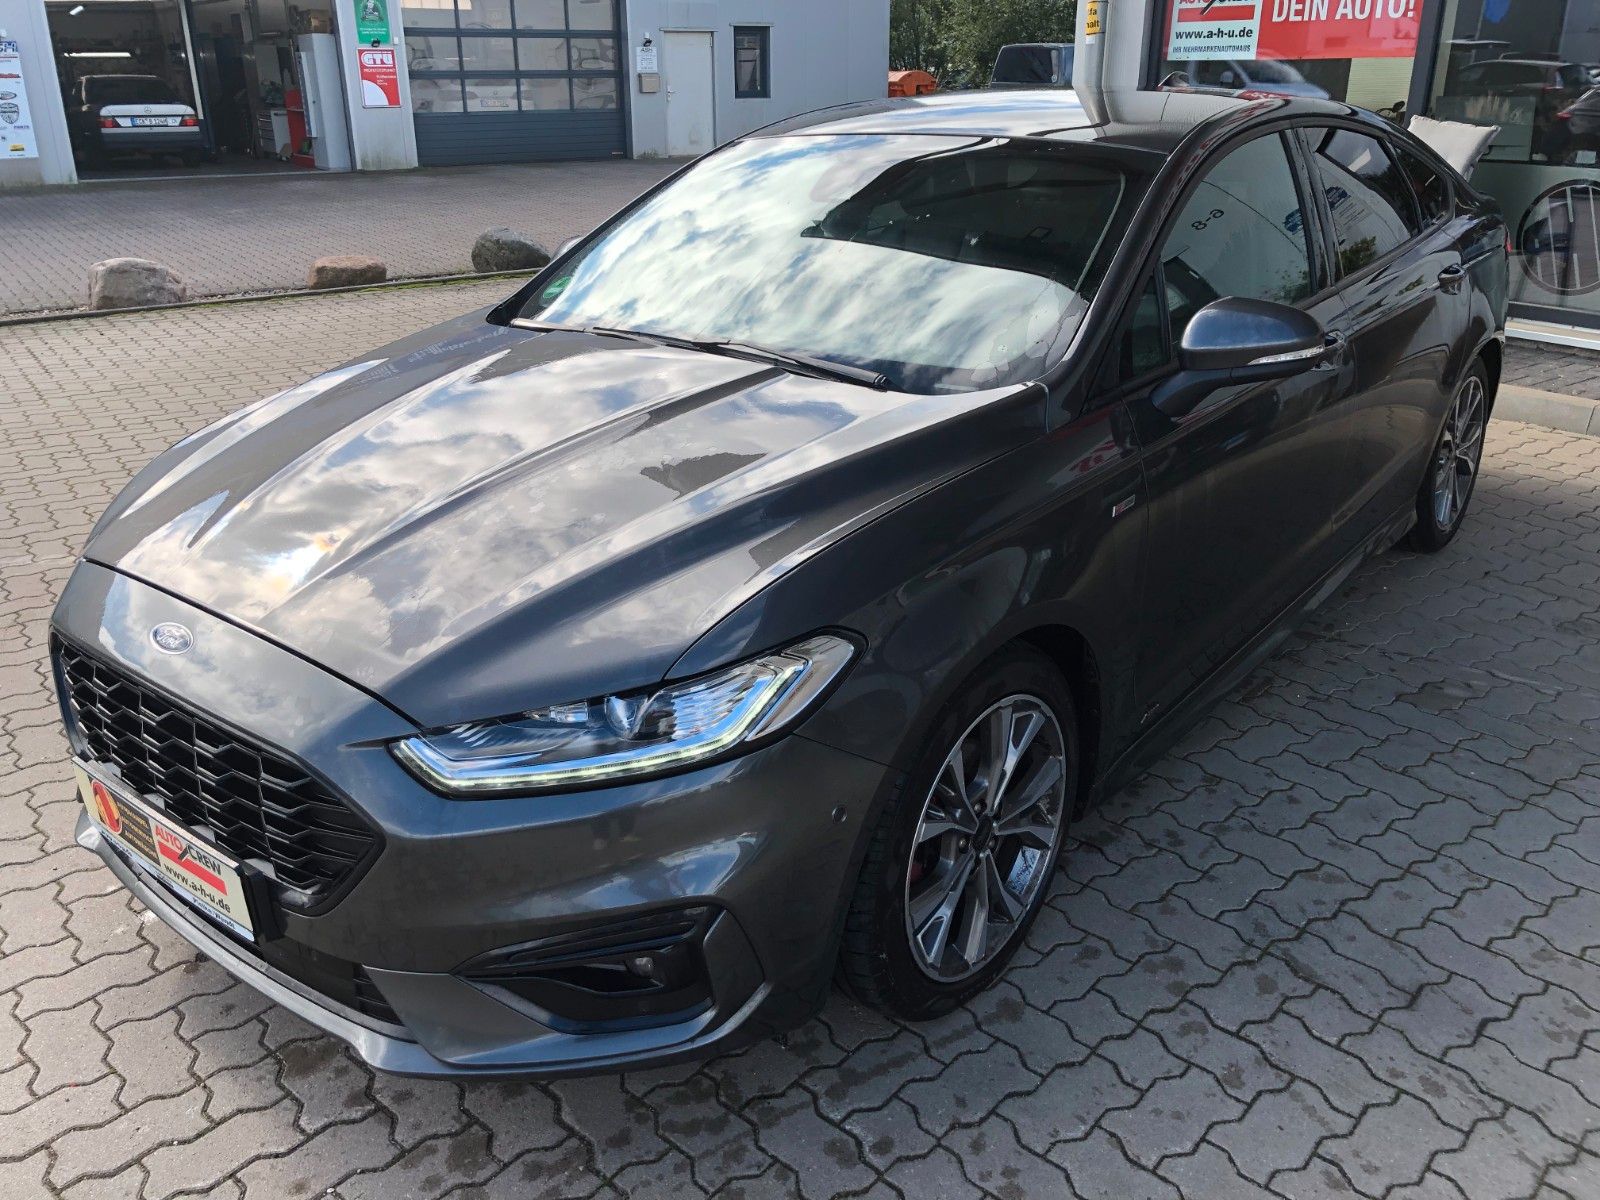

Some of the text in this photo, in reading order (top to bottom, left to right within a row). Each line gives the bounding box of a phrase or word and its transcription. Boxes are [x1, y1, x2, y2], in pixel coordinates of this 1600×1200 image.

[1272, 0, 1329, 22] DEIN
[1175, 26, 1253, 40] www.a-h-u.de
[1183, 44, 1251, 53] MEHRMARKENAUTOHAUS
[155, 824, 184, 852] AUTO
[187, 843, 222, 876] CREW
[163, 863, 231, 914] www.a-h-u.de
